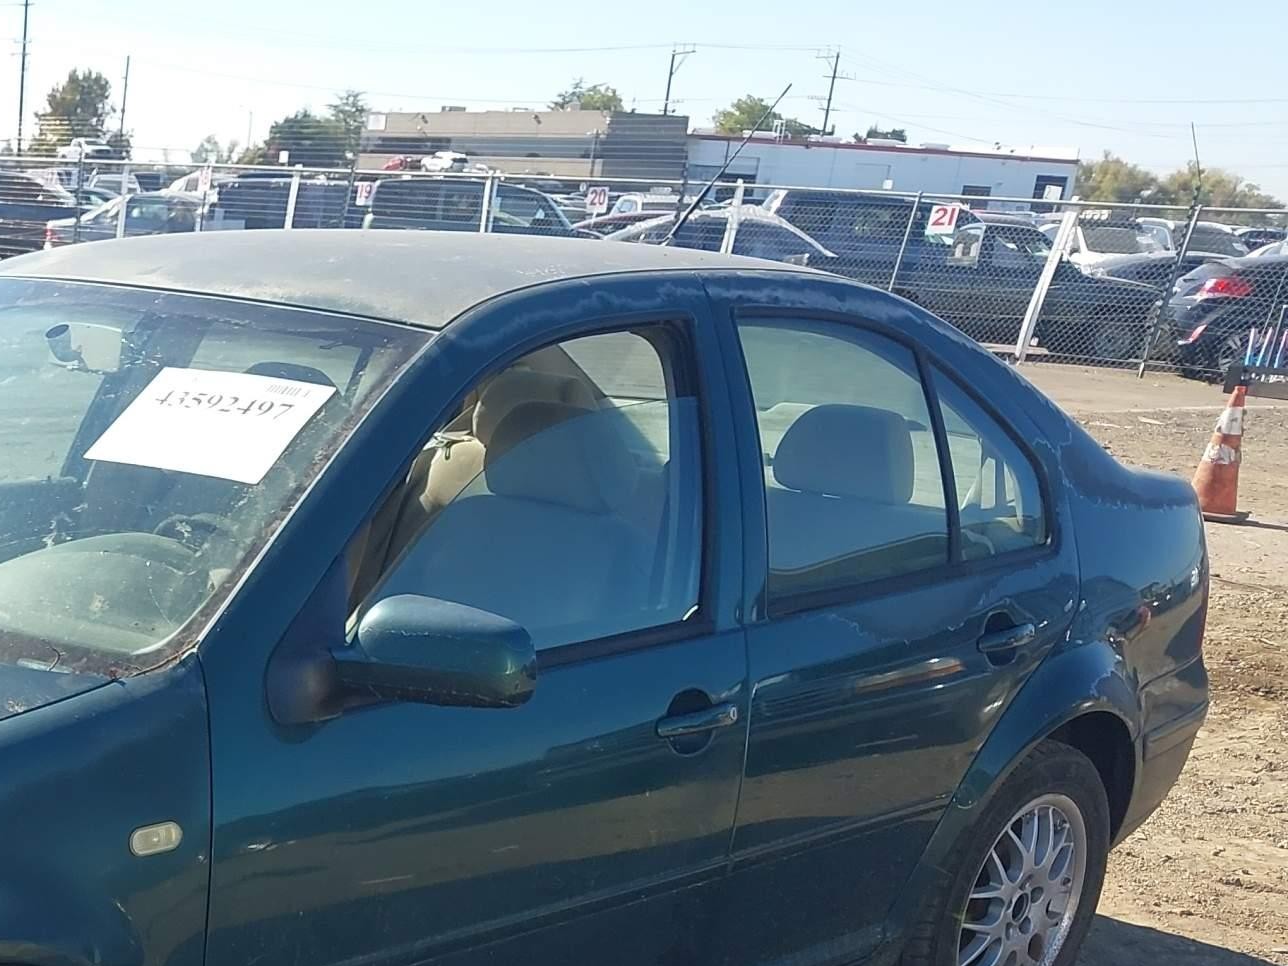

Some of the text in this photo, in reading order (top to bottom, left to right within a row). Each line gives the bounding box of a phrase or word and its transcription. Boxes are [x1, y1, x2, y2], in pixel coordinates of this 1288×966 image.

[359, 184, 372, 199] 19
[589, 189, 607, 206] 20
[931, 207, 956, 226] 21
[155, 390, 295, 420] 43592497
